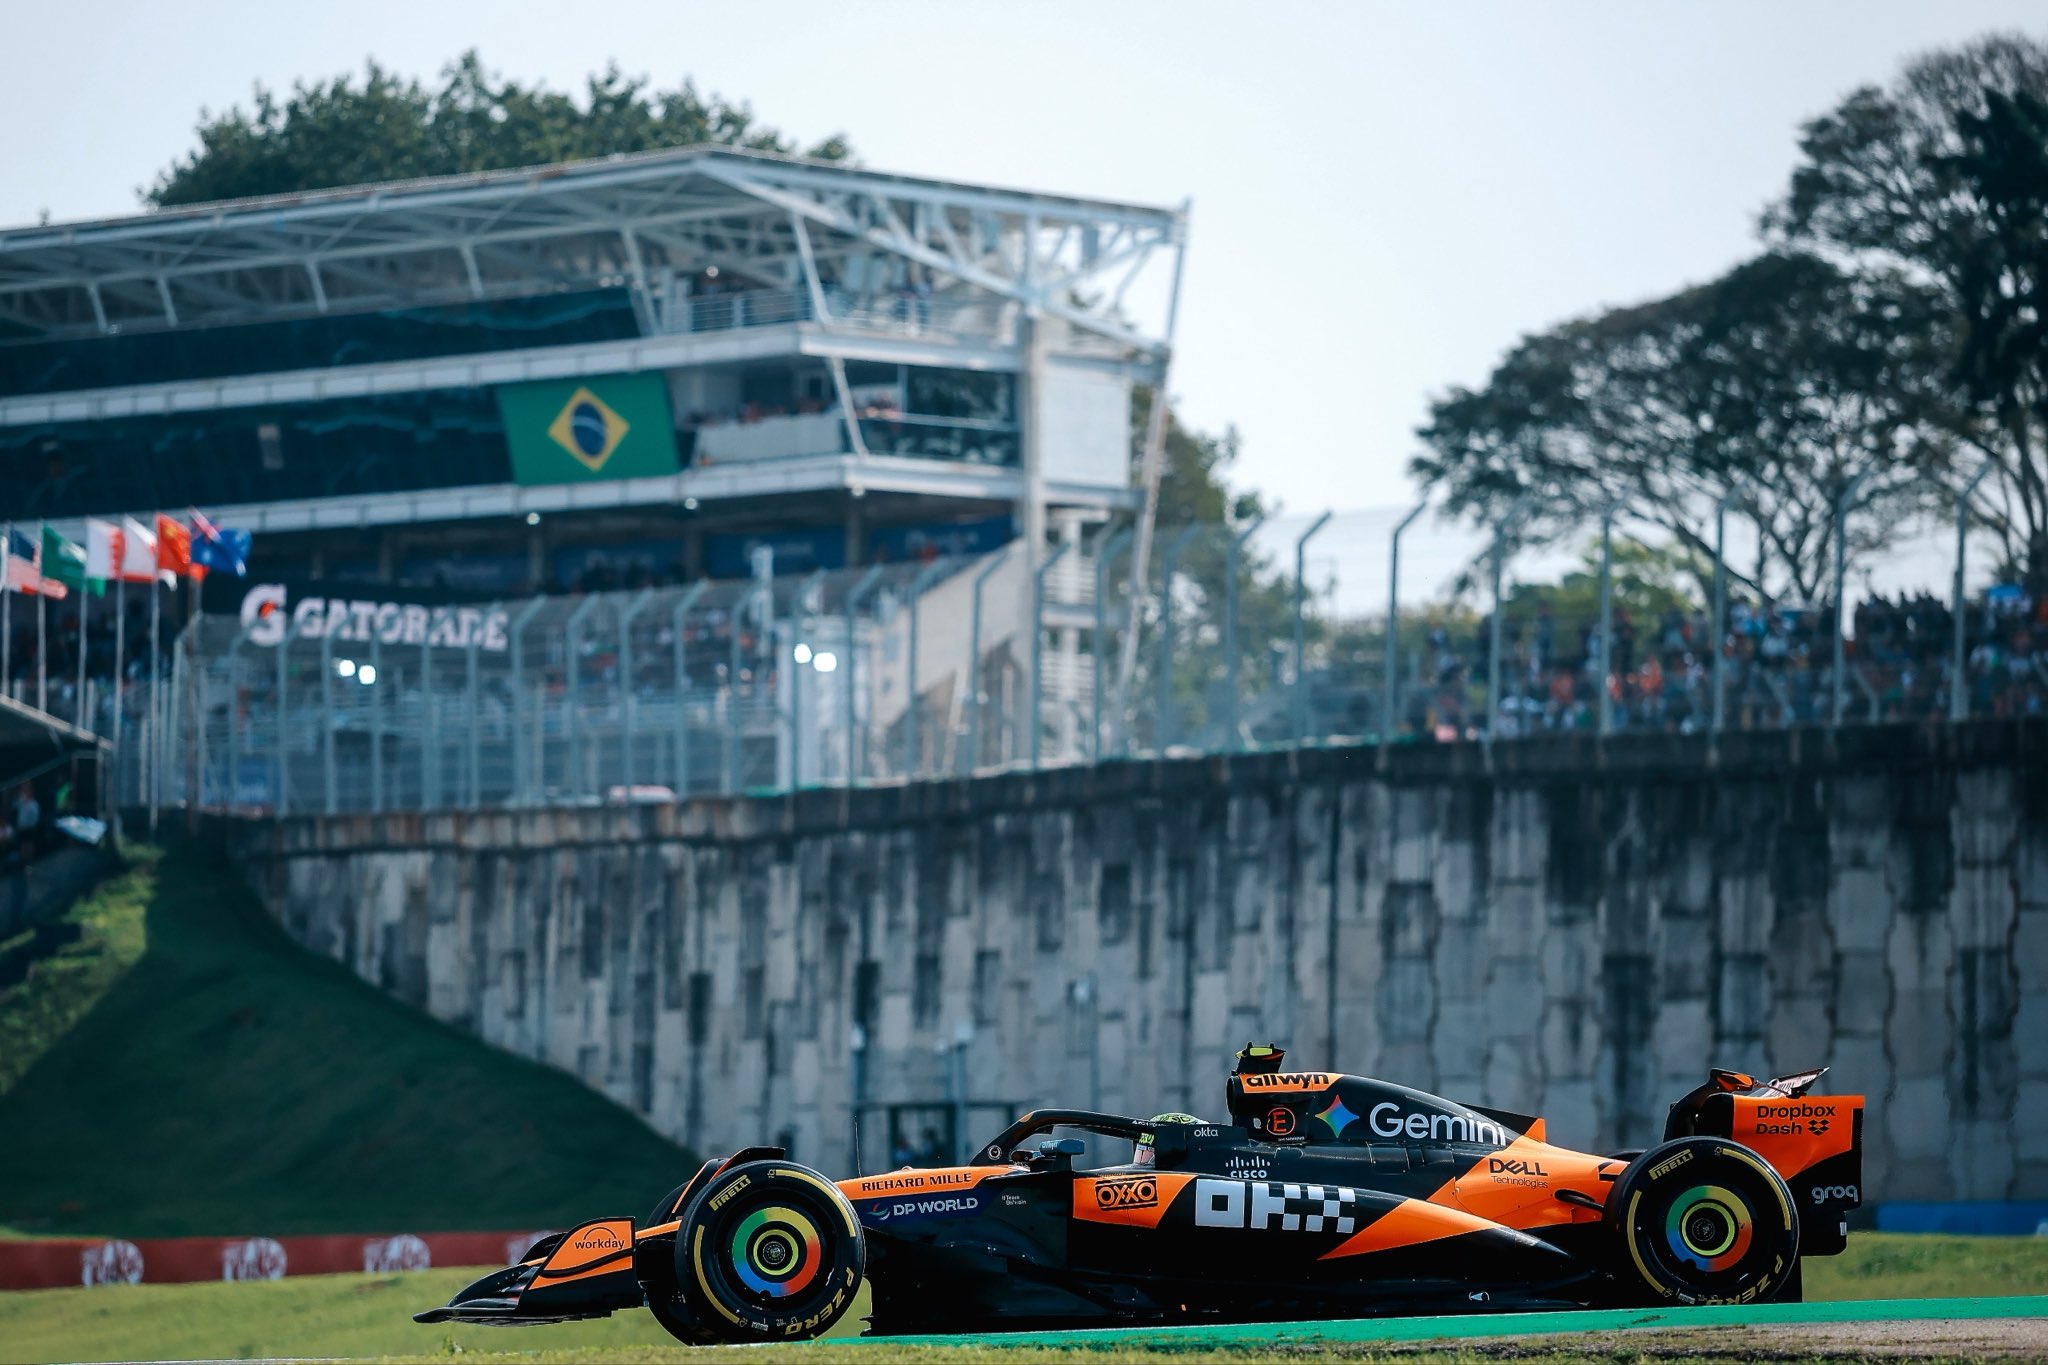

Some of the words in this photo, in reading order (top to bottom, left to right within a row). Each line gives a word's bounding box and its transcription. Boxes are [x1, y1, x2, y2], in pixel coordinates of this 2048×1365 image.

[295, 597, 509, 651] GATORADE
[1246, 1074, 1329, 1088] allwyn
[1757, 1104, 1835, 1120] Dropbox
[1194, 1127, 1218, 1137] okta
[1370, 1102, 1506, 1146] Gemini
[1756, 1123, 1802, 1135] Dash
[1489, 1158, 1548, 1176] DELL
[1649, 1149, 1694, 1180] PIRELLI
[862, 1176, 924, 1191] RICHARD
[929, 1173, 972, 1185] MILLE
[1491, 1175, 1548, 1189] Technologies
[708, 1174, 751, 1211] PIRELLI
[1097, 1182, 1156, 1206] OXXO
[1811, 1184, 1858, 1204] groq
[893, 1204, 915, 1216] DP
[919, 1197, 978, 1213] WORLD
[1195, 1178, 1356, 1233] OKX
[575, 1238, 624, 1249] workday
[1774, 1254, 1784, 1273] P
[846, 1267, 855, 1287] P
[785, 1288, 846, 1335] ZERO
